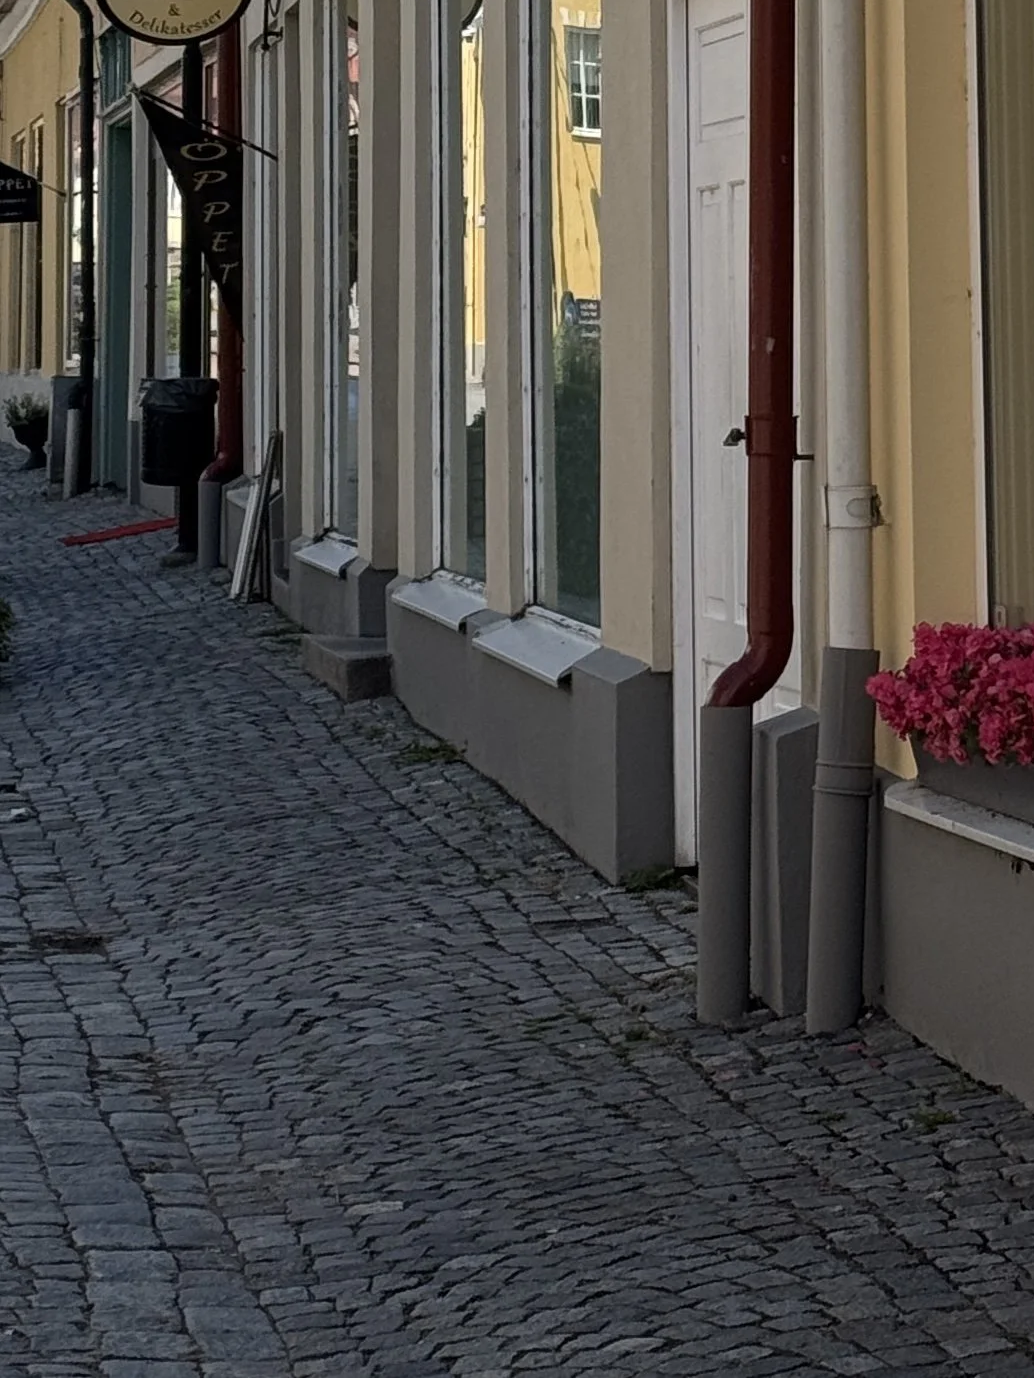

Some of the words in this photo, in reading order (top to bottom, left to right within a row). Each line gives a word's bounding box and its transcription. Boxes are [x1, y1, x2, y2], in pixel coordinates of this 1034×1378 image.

[129, 8, 223, 36] Delikatesser
[168, 3, 181, 17] &
[180, 137, 239, 284] ÖPPET
